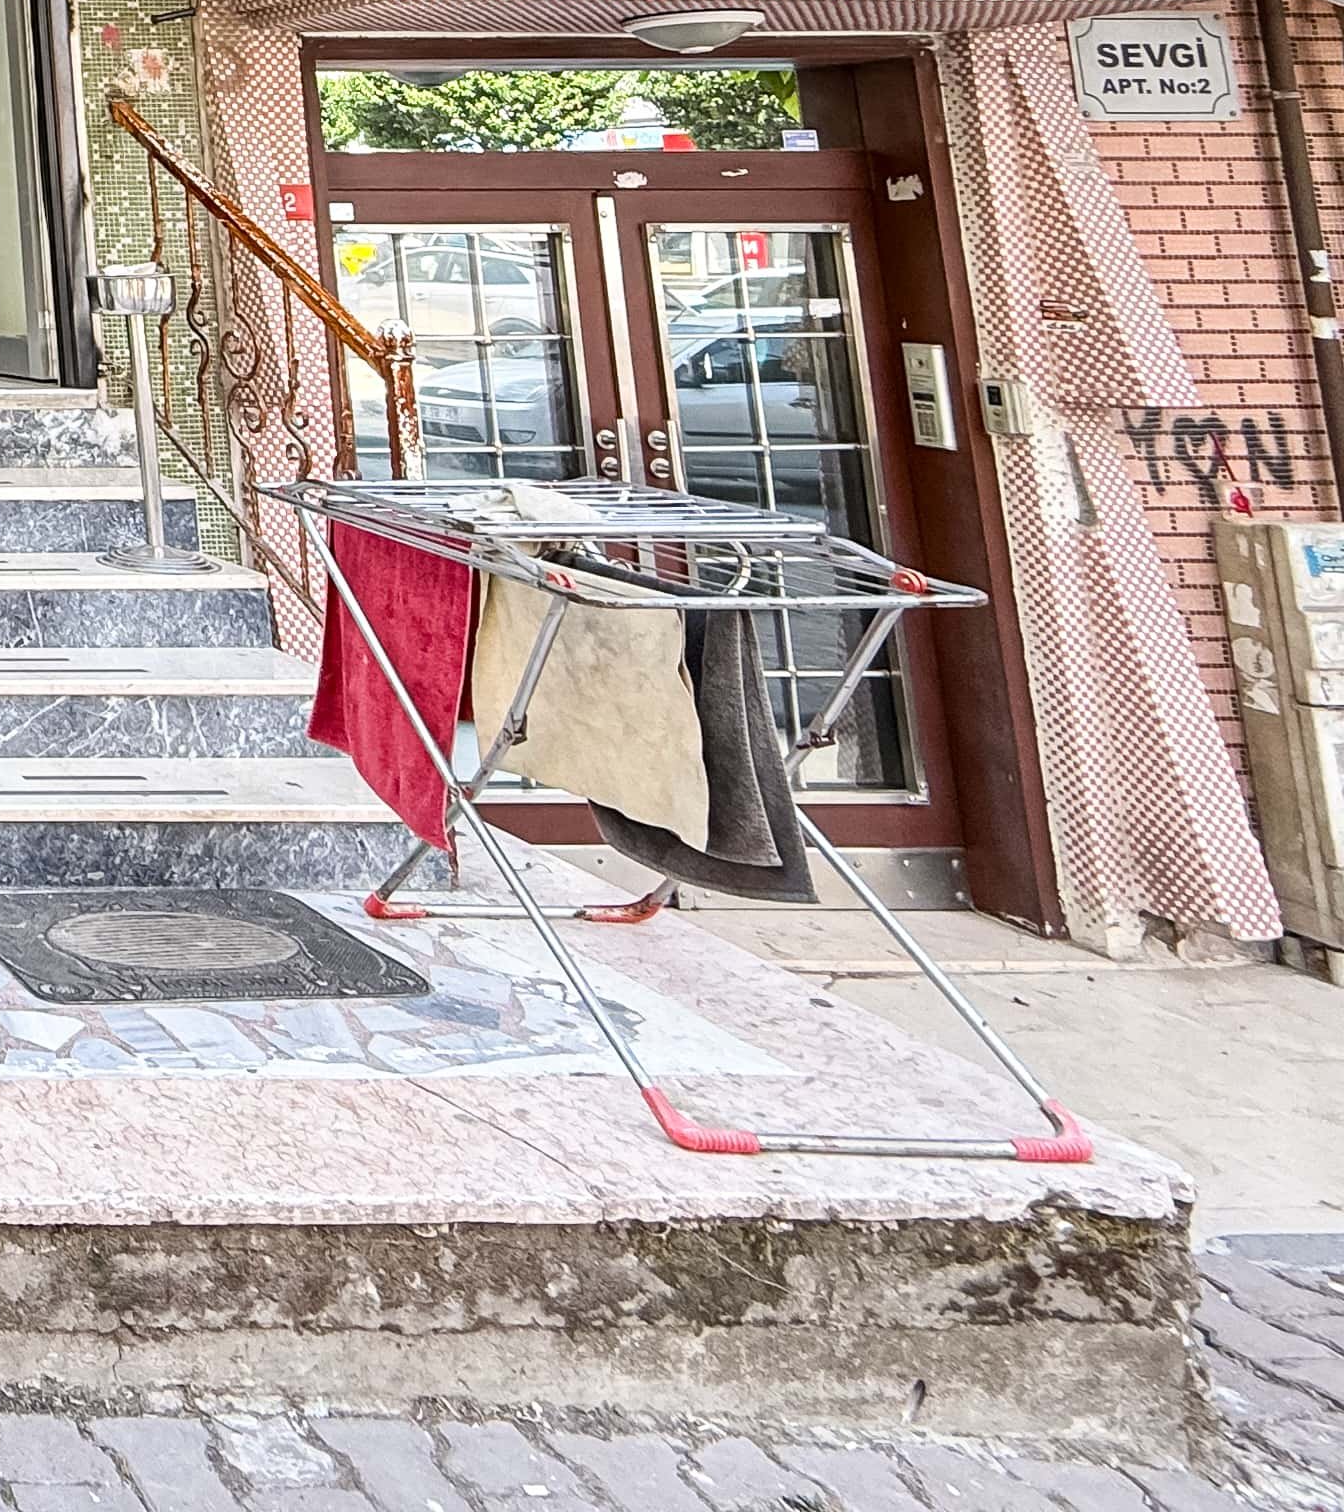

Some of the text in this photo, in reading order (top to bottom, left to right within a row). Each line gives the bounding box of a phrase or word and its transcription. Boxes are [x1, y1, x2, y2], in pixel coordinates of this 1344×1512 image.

[1097, 37, 1208, 68] SEVGİ
[1102, 78, 1211, 94] APT. No:2
[284, 193, 297, 212] 2
